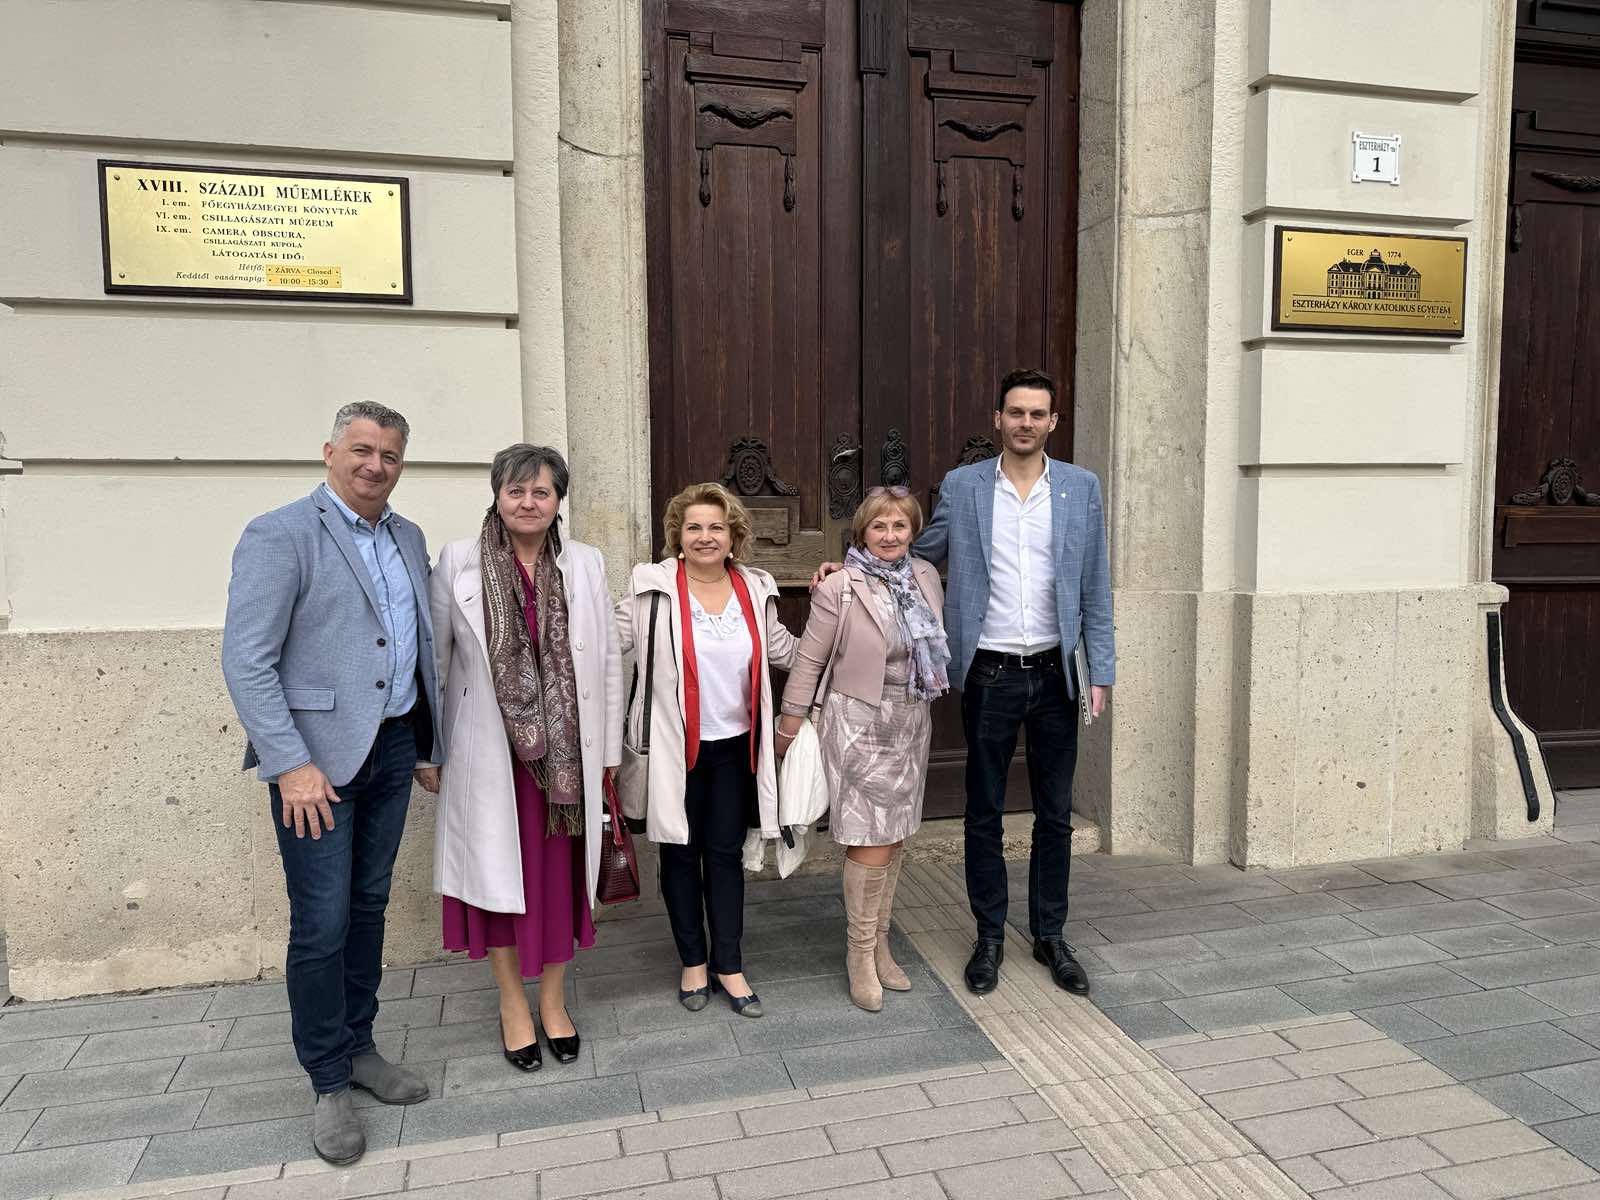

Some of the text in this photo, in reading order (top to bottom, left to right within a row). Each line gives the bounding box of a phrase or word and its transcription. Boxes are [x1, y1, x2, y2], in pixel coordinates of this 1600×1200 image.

[1372, 156, 1381, 173] 1
[137, 178, 373, 204] XVIII. SZÁZADI MŰEMLÉKEK
[201, 199, 298, 213] FŐEGYHÁZMEGYEI
[303, 205, 358, 216] KÖNYVTÁR
[155, 211, 170, 220] VI.
[201, 213, 284, 225] CSILLAGÁSZATI
[289, 217, 334, 227] MÚZEUM
[156, 225, 171, 233] IX.
[202, 227, 247, 237] CAMERA
[252, 229, 306, 240] OBSCURA,
[203, 238, 303, 249] CSILLAGÁSZATI KUPOLA
[212, 248, 278, 259] LÁTOGATÁSI
[1347, 248, 1364, 257] EGER
[175, 271, 209, 280] Keddtől
[214, 274, 265, 283] vasárnapig:
[280, 278, 301, 286] 10:00
[308, 278, 329, 286] 15:30
[275, 267, 301, 275] ZÁRVA
[1292, 298, 1451, 315] ESZTERHÁZY KÁROLY KATOLIKUS EGYETEM
